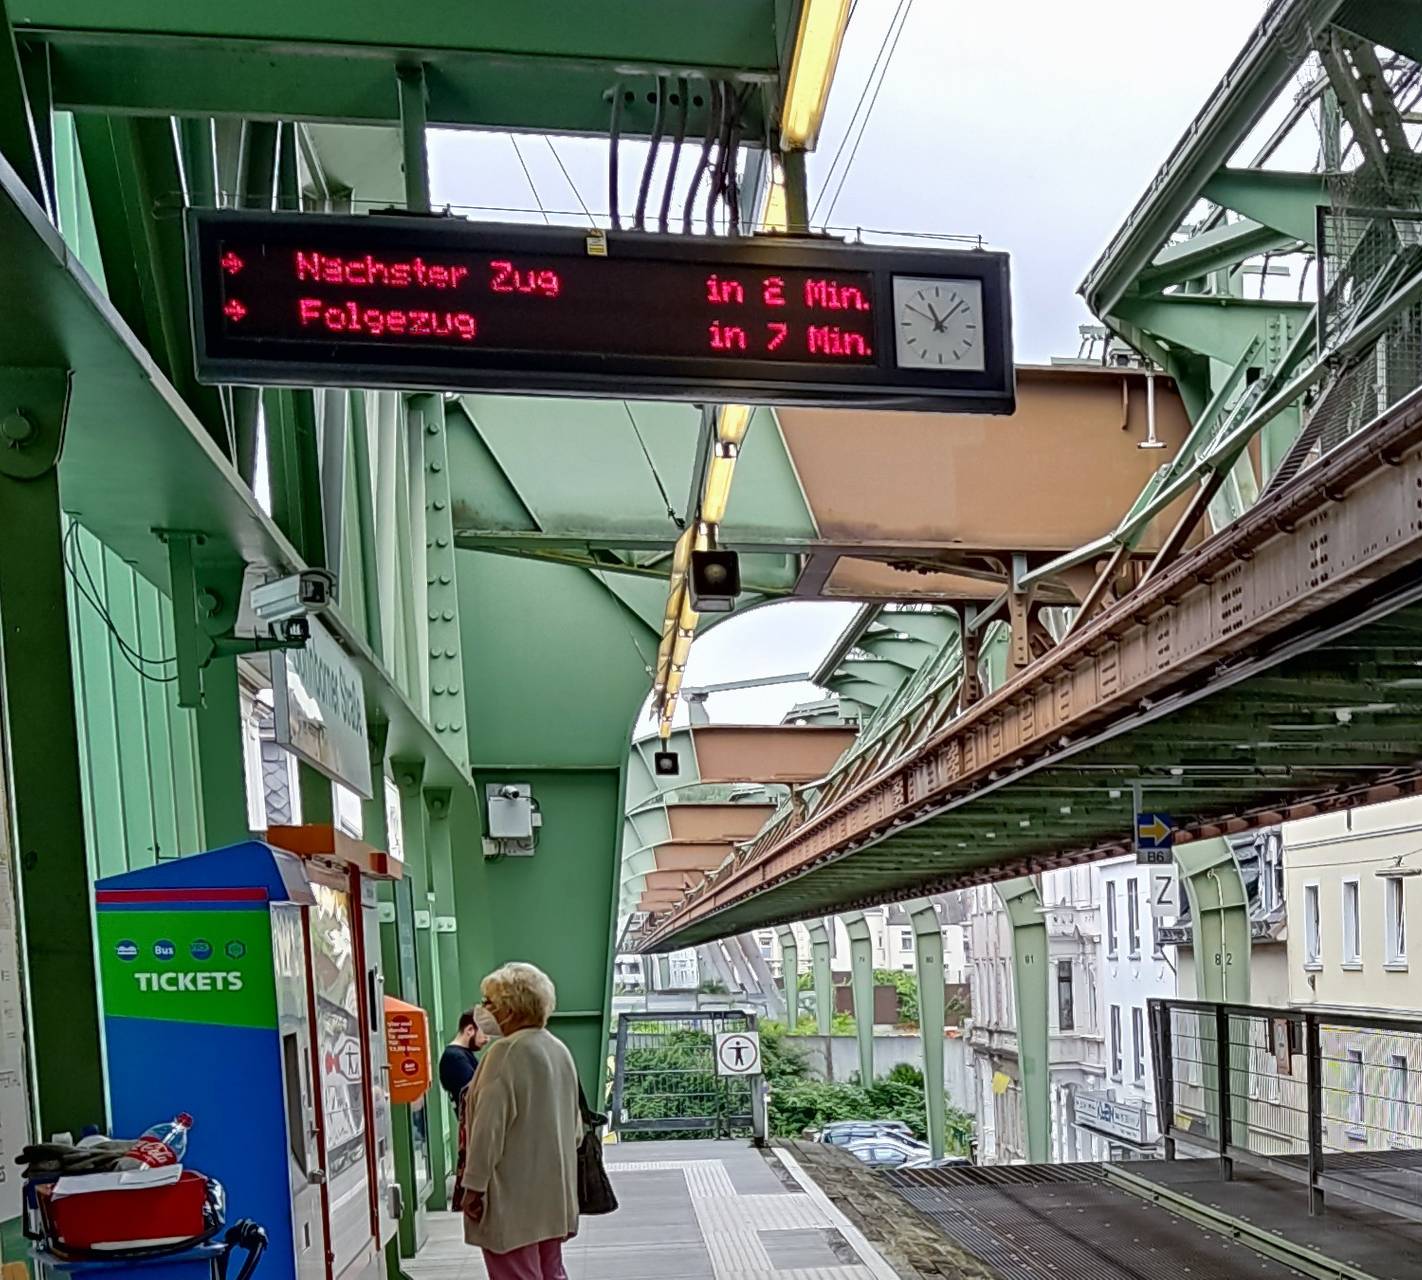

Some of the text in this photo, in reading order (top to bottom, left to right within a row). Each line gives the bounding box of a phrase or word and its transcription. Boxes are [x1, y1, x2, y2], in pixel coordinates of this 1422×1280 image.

[297, 252, 870, 311] Nächster Zug in 2 Min.
[300, 299, 873, 357] Folgezug in 7 Min.
[1147, 851, 1165, 863] B6
[1155, 876, 1173, 905] Z
[154, 945, 174, 955] Bus
[134, 972, 243, 991] TICKETS
